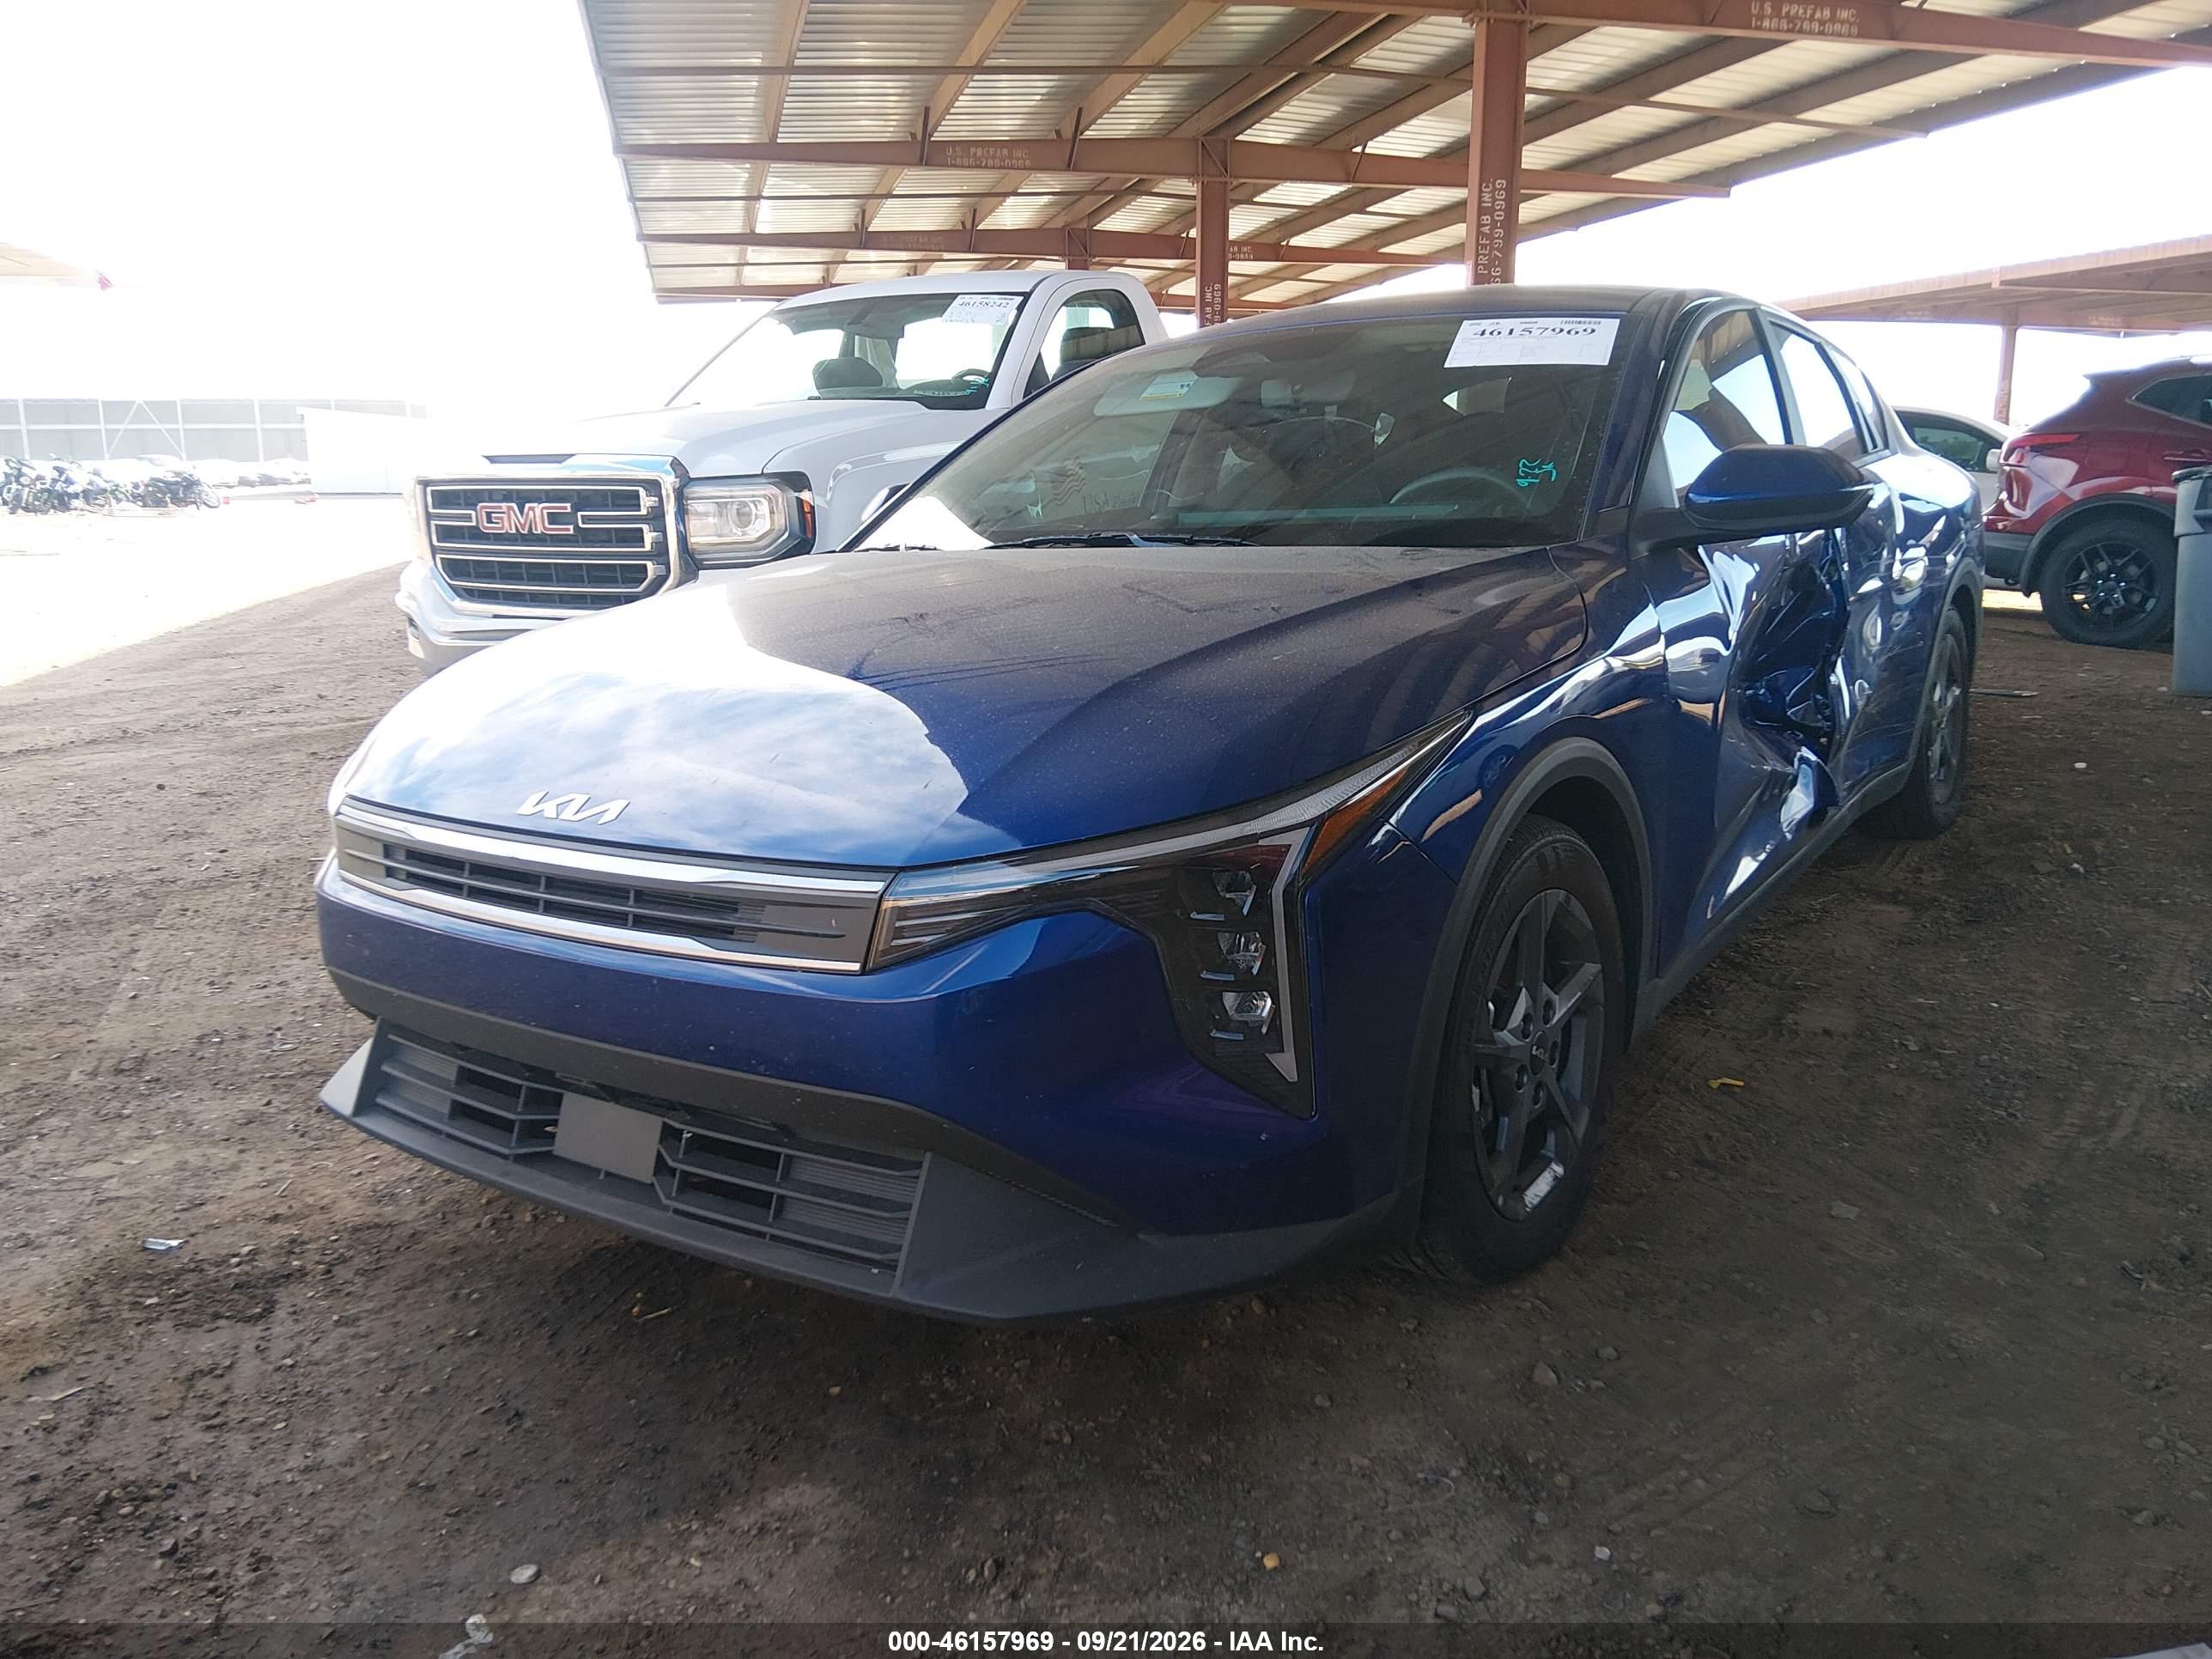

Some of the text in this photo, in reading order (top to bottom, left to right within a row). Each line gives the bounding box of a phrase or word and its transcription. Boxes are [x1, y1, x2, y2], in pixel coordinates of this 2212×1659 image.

[1782, 3, 1831, 20] PREFAB
[969, 147, 1009, 158] PREFAB
[1477, 178, 1493, 274] PREFAB INC.
[1473, 326, 1596, 337] 46157969
[477, 501, 574, 534] GMC
[515, 789, 631, 826] KIA
